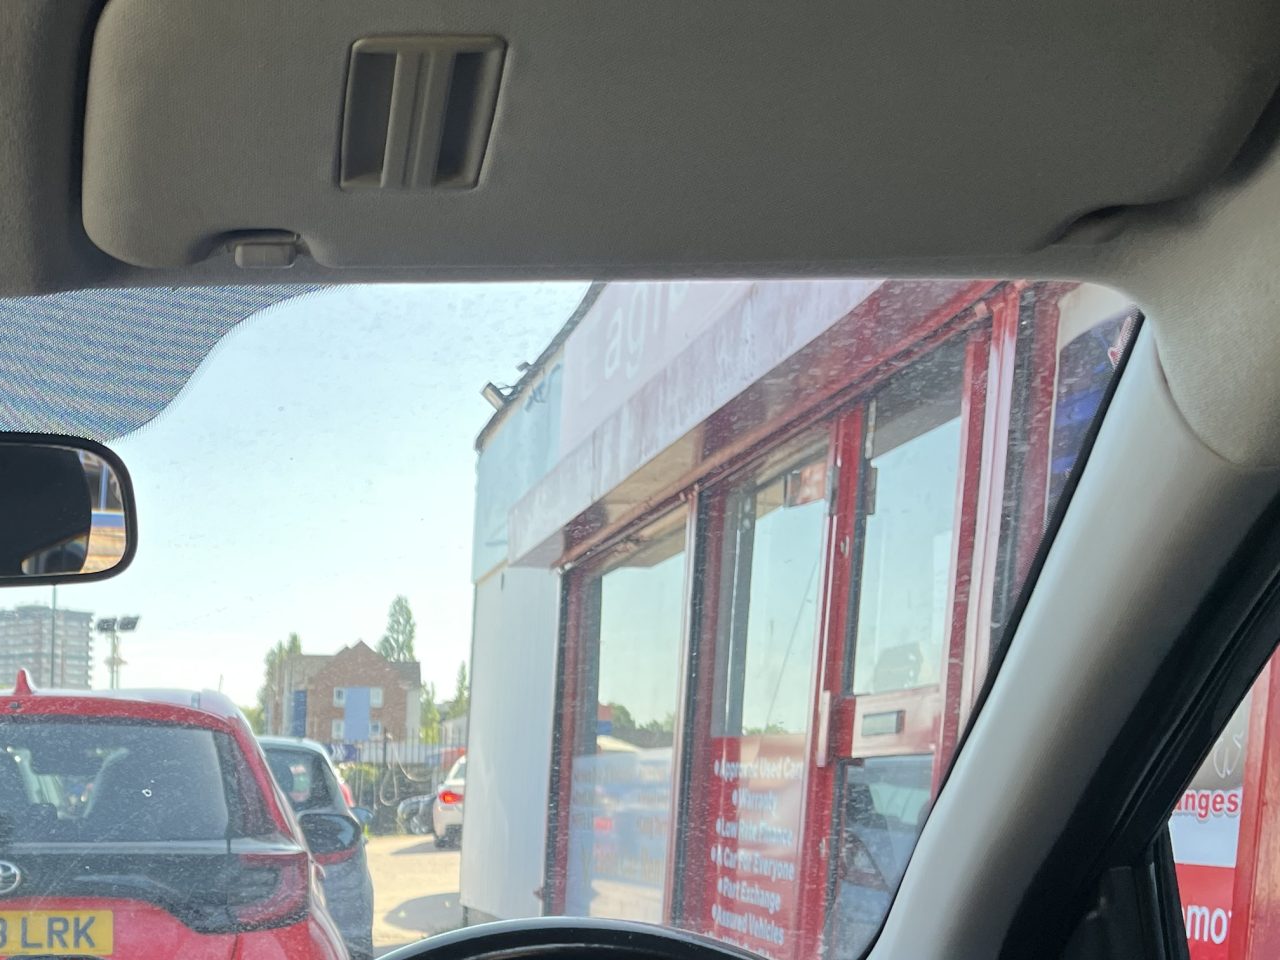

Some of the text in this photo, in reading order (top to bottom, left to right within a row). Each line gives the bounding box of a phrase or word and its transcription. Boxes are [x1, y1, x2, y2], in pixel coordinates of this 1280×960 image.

[759, 757, 782, 778] Used
[738, 788, 777, 817] Warranty
[721, 816, 793, 847] Low Rate Finance
[724, 846, 737, 869] Car
[738, 848, 751, 872] For
[752, 851, 795, 882] Everyone
[741, 880, 781, 914] Exchange
[21, 916, 96, 949] LRK
[716, 904, 785, 945] Assured Vehicles
